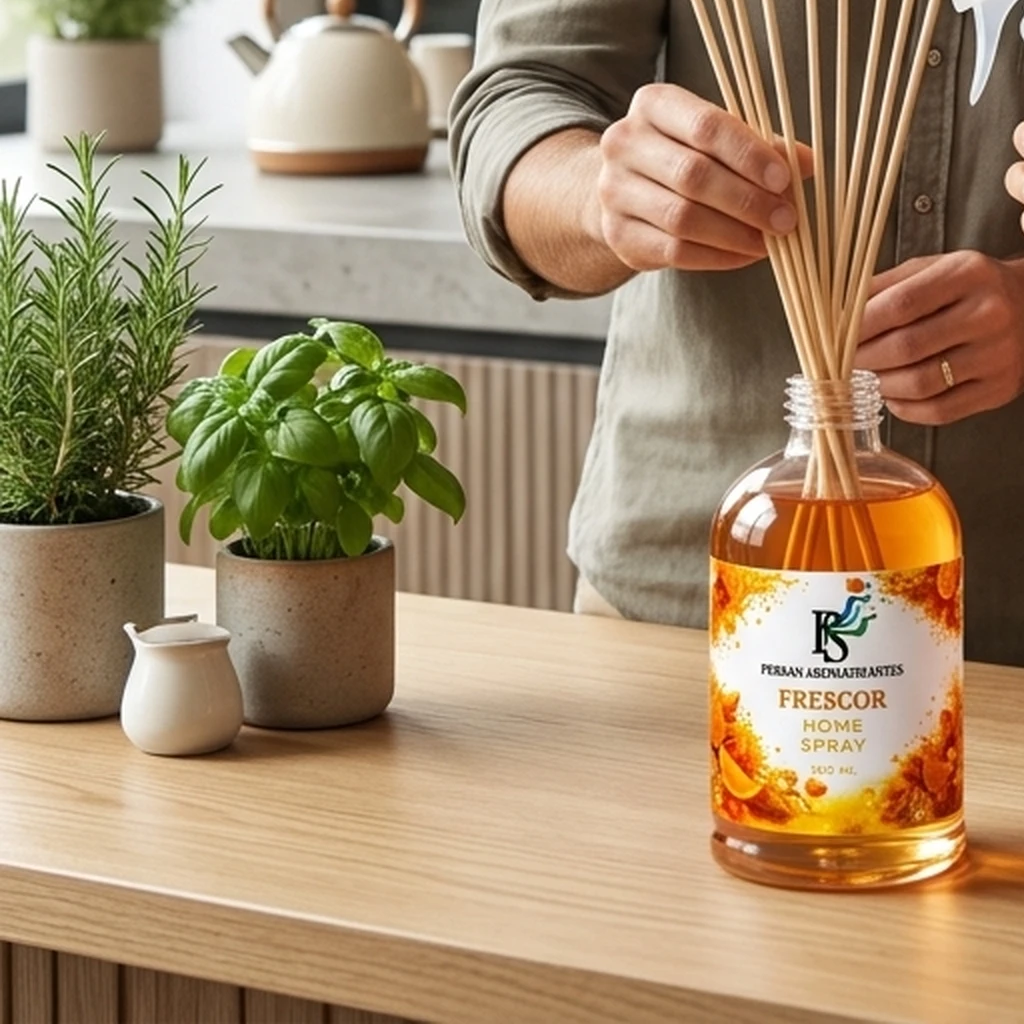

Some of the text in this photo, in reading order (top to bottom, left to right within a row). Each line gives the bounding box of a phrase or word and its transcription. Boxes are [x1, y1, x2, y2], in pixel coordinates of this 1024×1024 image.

[778, 689, 887, 710] FRESCOR
[803, 719, 863, 733] HOME
[801, 737, 866, 752] SPRAY
